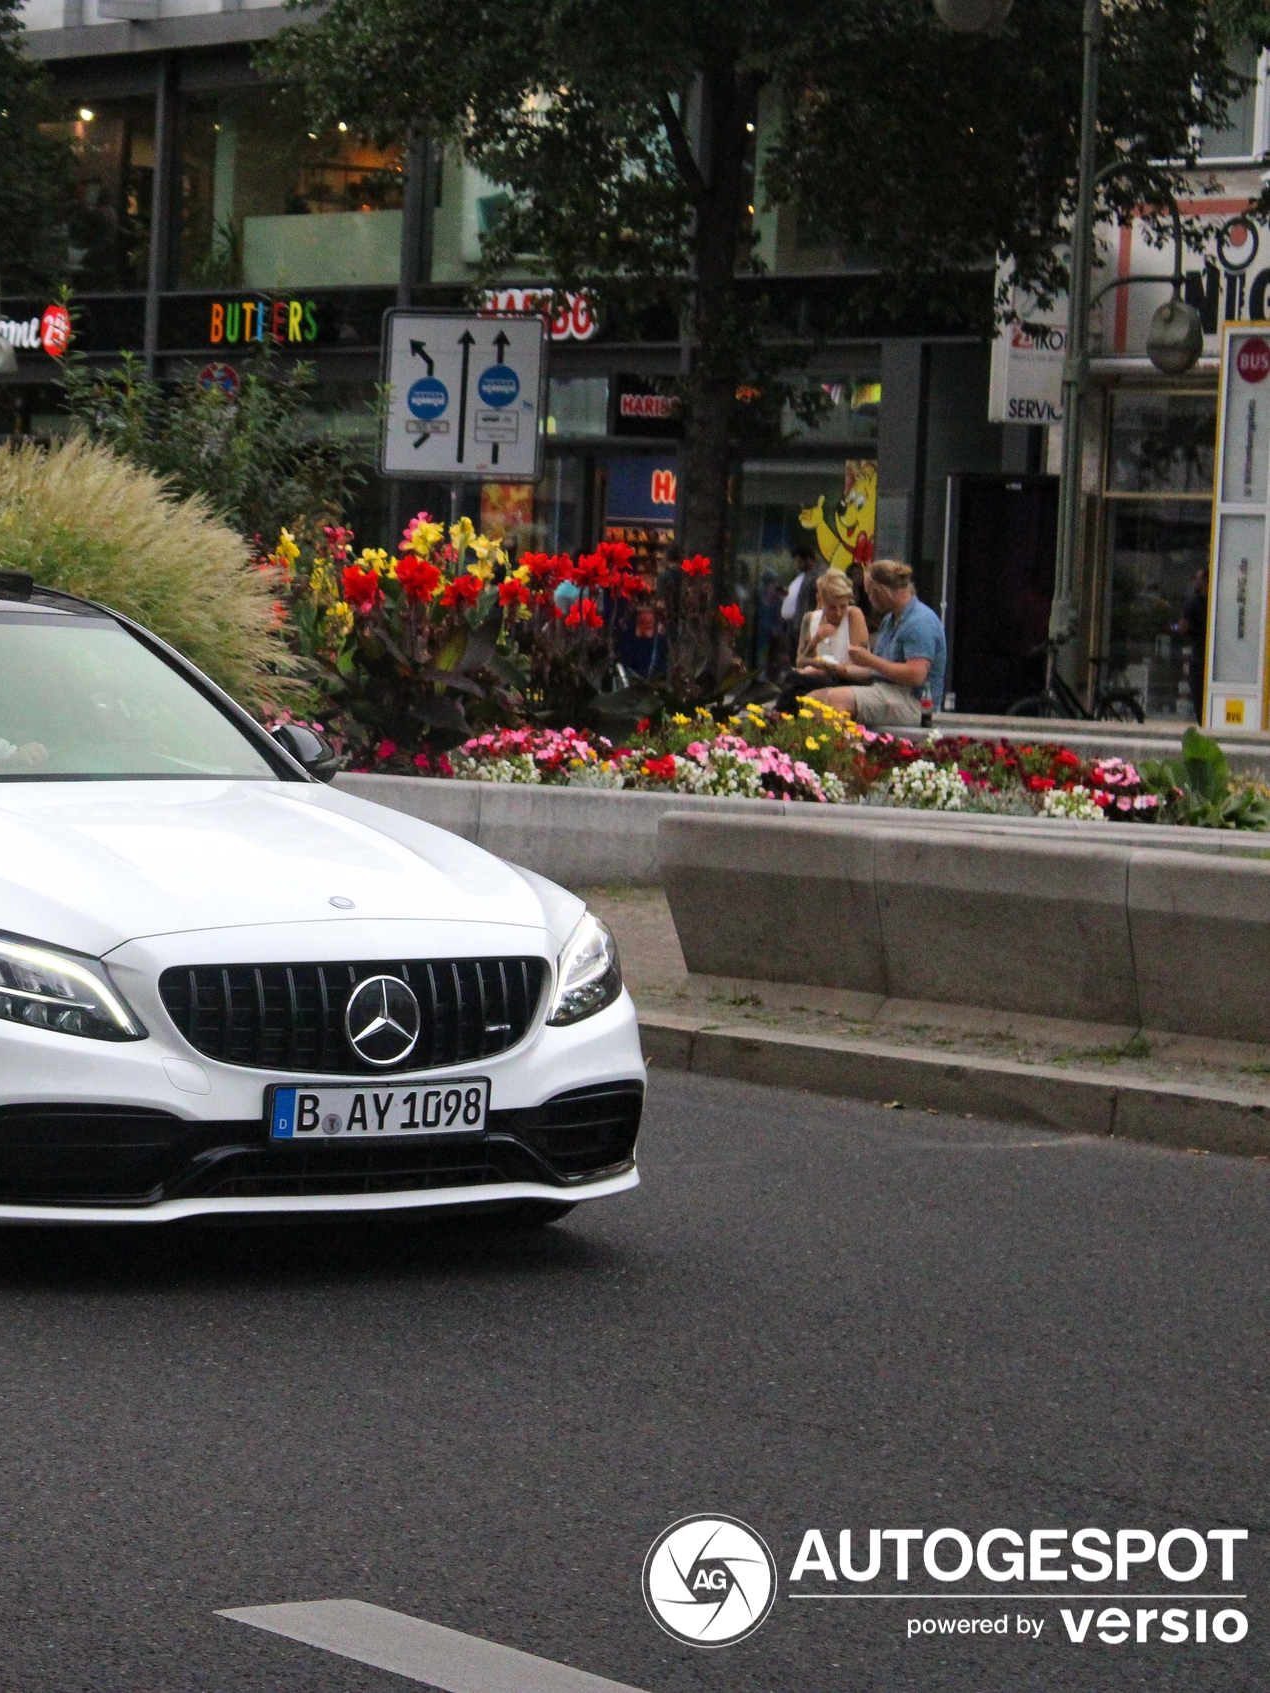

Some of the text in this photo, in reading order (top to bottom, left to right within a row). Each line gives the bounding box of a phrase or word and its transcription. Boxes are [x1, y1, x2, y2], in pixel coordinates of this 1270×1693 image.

[211, 301, 317, 342] BUTLERS
[1241, 356, 1269, 370] BUS
[296, 1087, 482, 1132] B AY 1098
[279, 1118, 288, 1130] D
